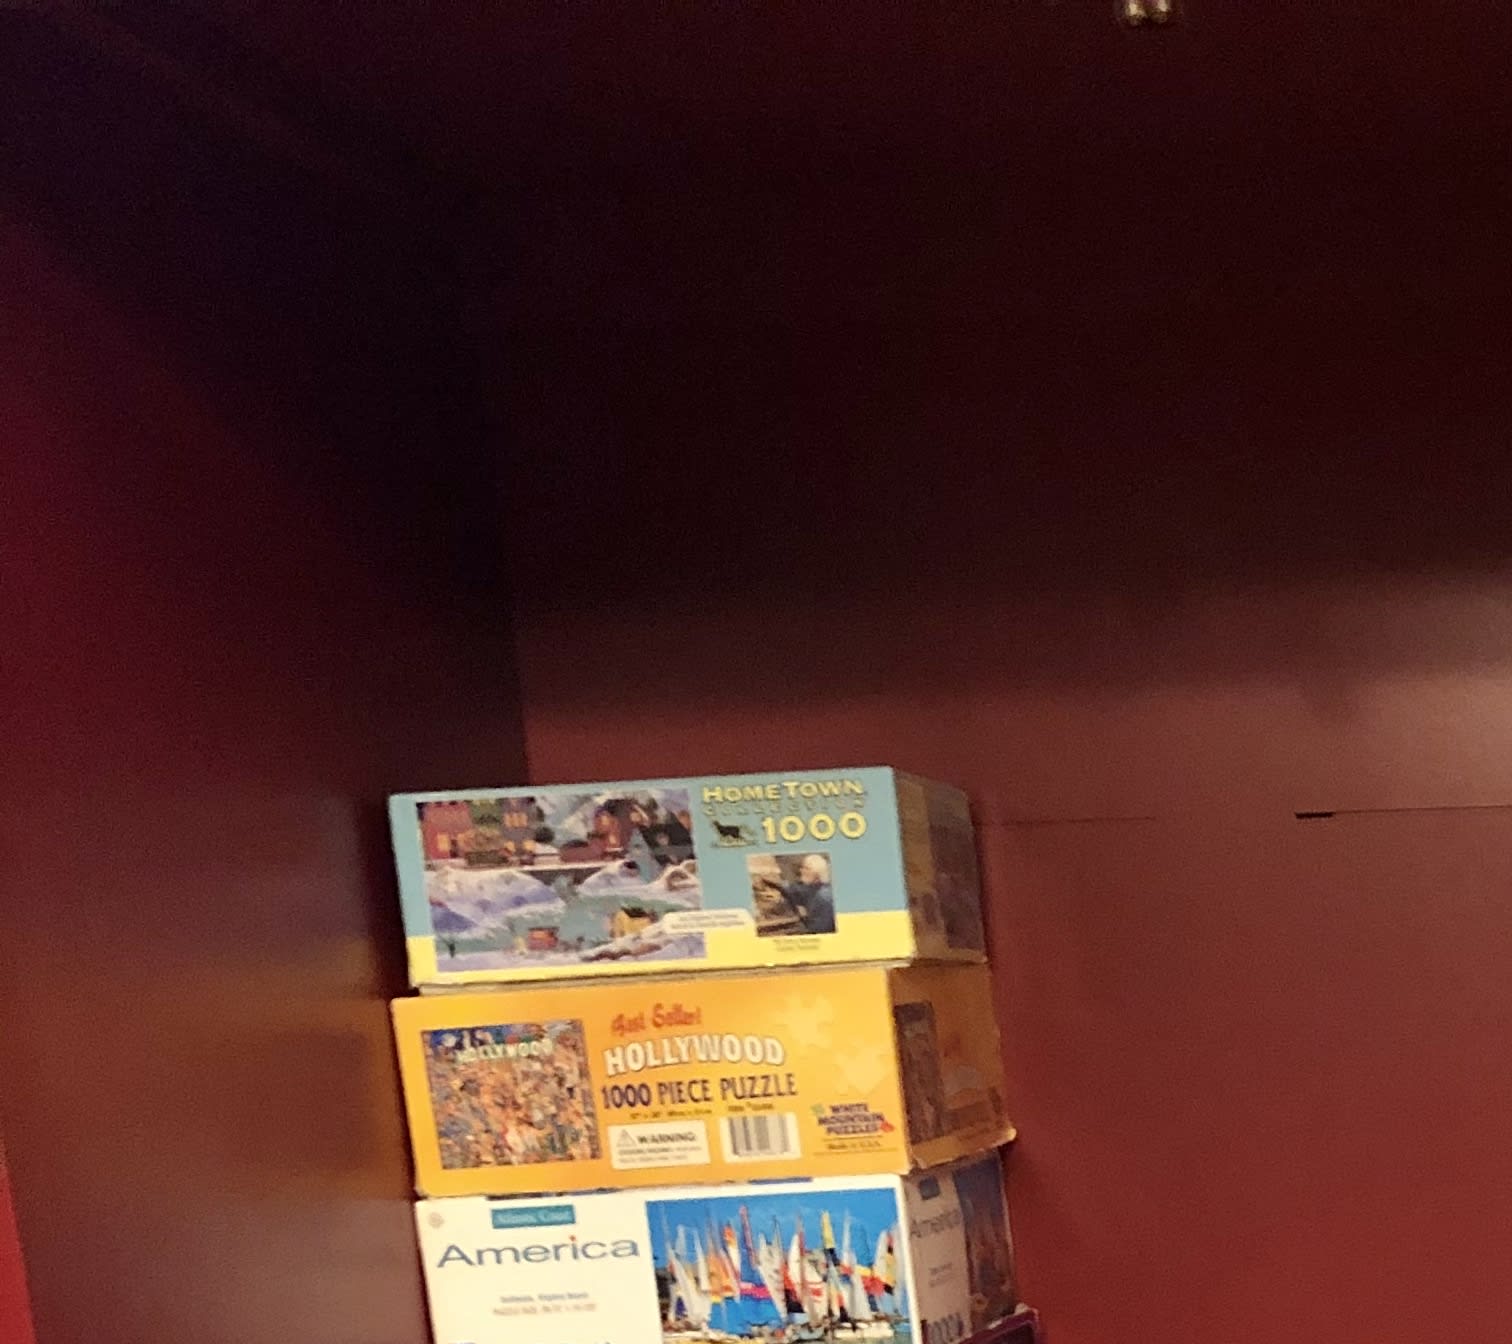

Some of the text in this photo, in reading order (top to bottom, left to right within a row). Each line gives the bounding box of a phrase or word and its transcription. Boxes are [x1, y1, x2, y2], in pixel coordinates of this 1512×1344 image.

[762, 811, 867, 843] 1000
[604, 1033, 785, 1077] HOLLYWOOD
[601, 1072, 798, 1110] 1000 PIECE PUZZLE
[817, 1112, 884, 1126] MOUNTAIN
[830, 1103, 869, 1114] WHITE
[637, 1131, 697, 1146] WARNING
[826, 1123, 880, 1136] PUZZLES
[437, 1234, 640, 1268] America
